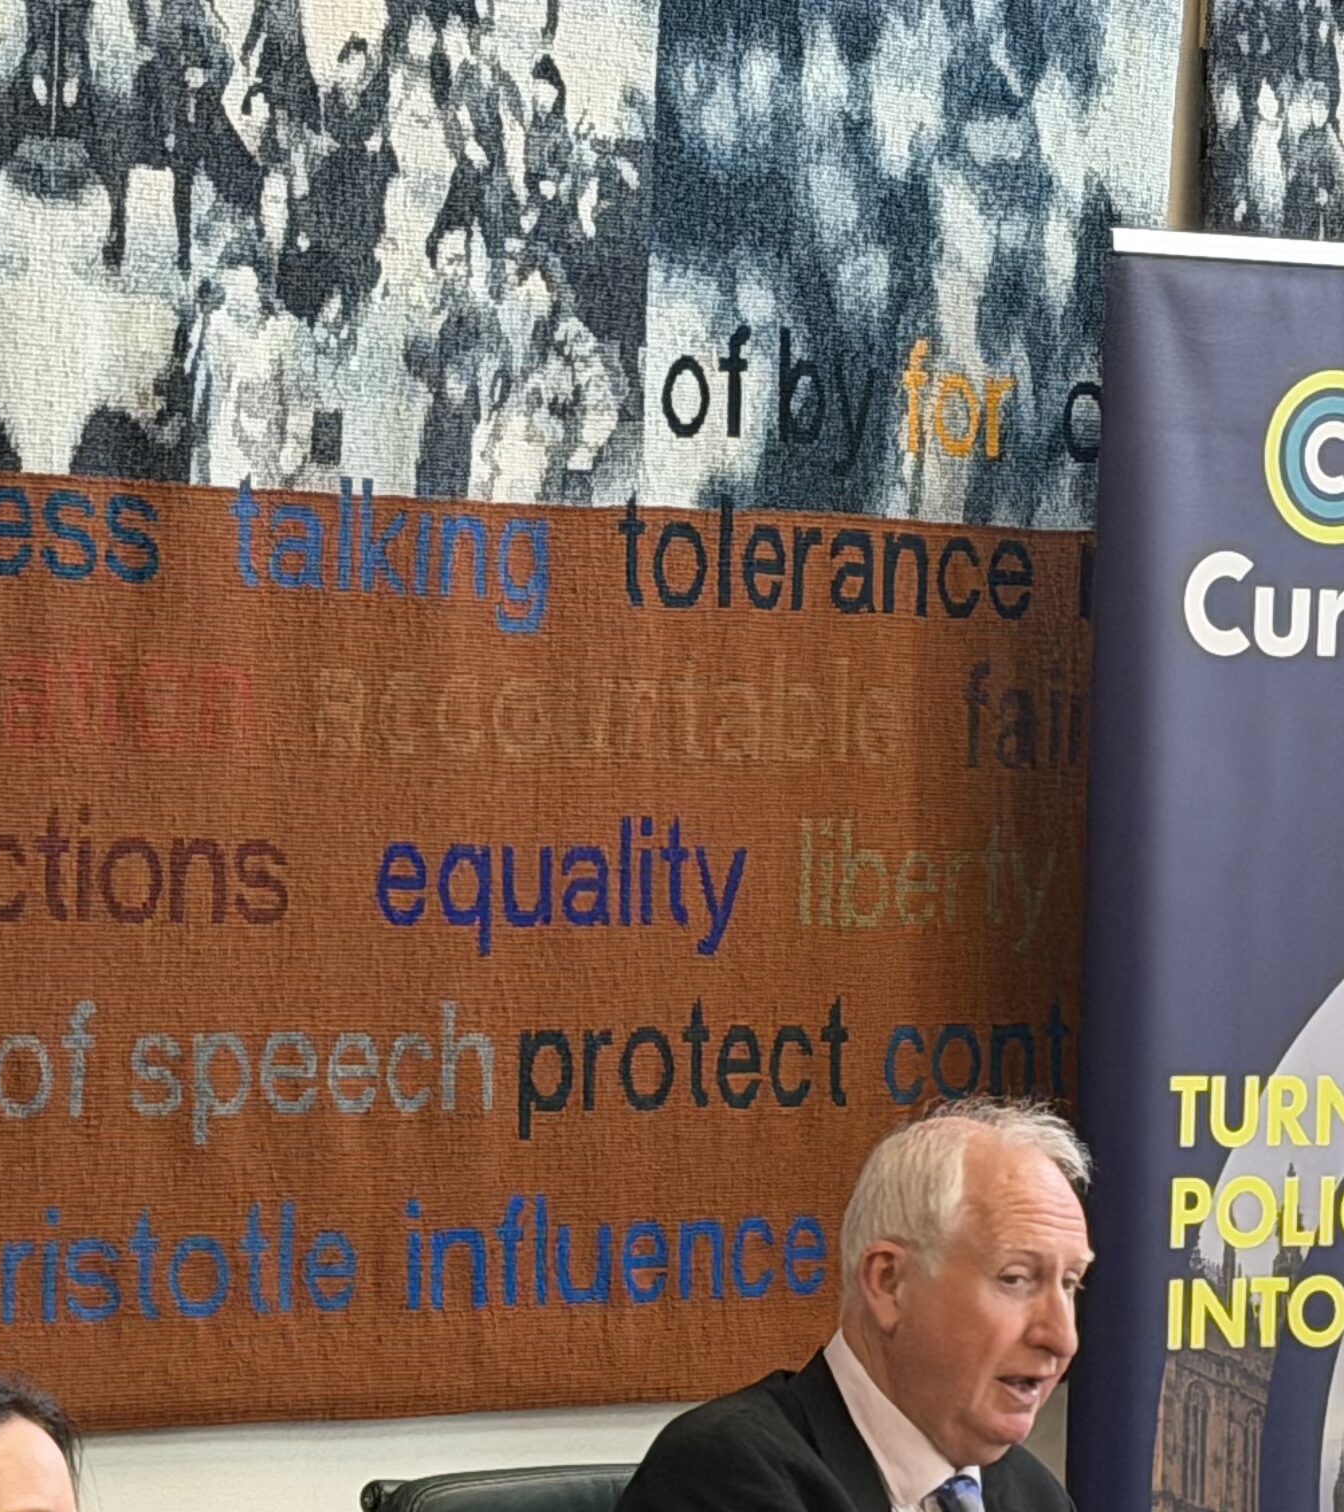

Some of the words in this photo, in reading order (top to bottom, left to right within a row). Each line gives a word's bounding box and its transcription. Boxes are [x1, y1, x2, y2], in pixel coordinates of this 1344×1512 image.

[663, 325, 749, 437] of
[780, 327, 874, 476] by
[904, 337, 1015, 460] for
[229, 476, 550, 634] talking
[618, 498, 1034, 621] tolerance
[377, 817, 747, 956] equality
[799, 817, 1056, 953] liberty
[130, 1002, 495, 1146] speech
[518, 996, 851, 1140] protect
[407, 1194, 827, 1312] influence
